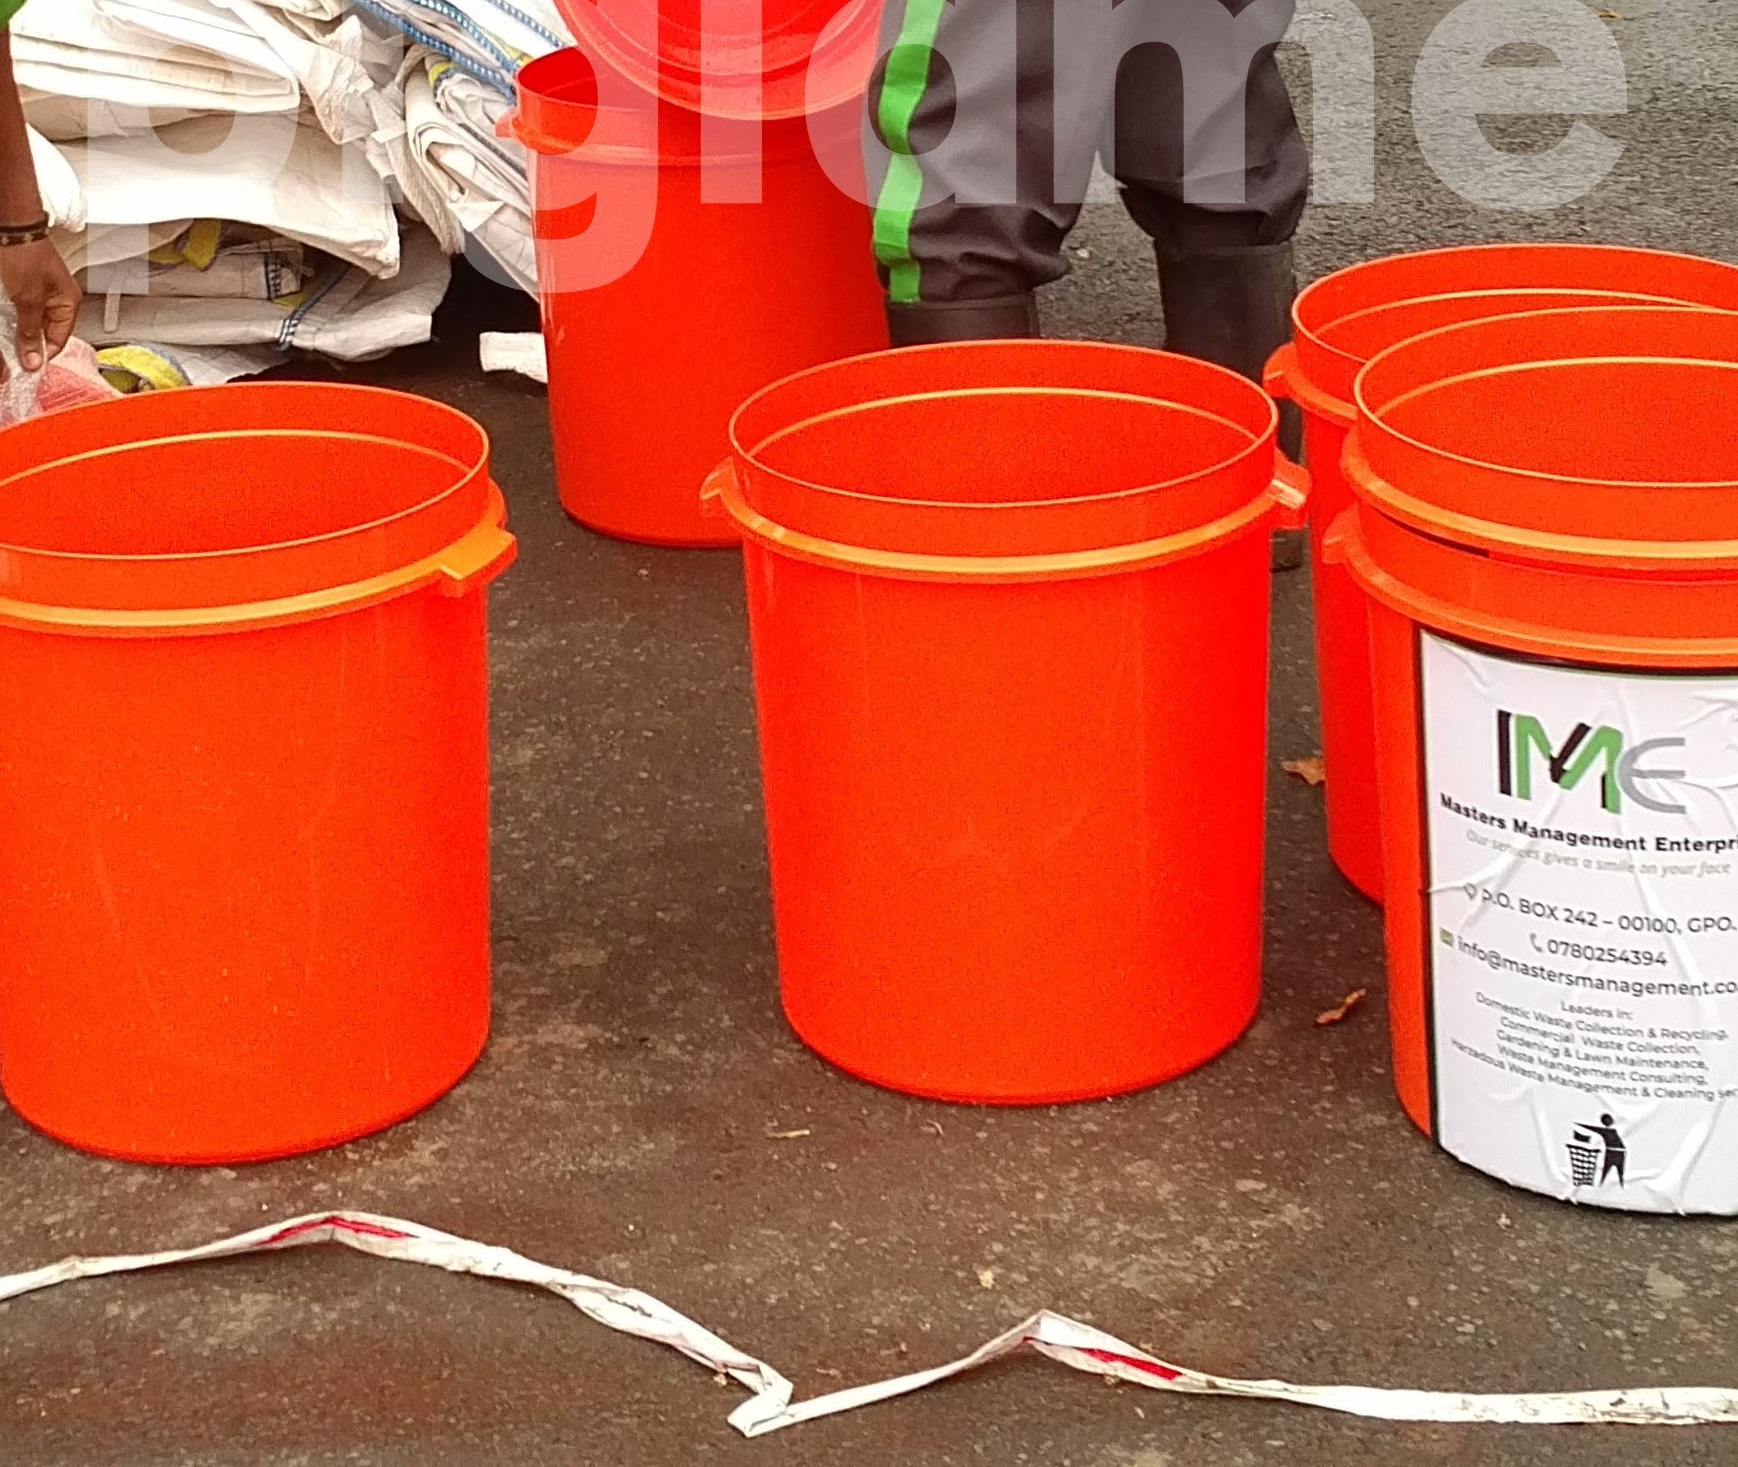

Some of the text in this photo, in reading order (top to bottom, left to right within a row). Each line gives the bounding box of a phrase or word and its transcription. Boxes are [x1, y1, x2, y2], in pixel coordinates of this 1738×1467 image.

[1439, 792, 1507, 830] Masters
[1512, 818, 1648, 851] Management
[1595, 859, 1635, 873] smile
[1661, 863, 1695, 879] your
[1696, 861, 1731, 878] face
[1518, 897, 1559, 921] BOX
[1562, 907, 1599, 928] 242
[1617, 914, 1682, 935] 00100,
[1687, 916, 1738, 933] GPO.
[1547, 938, 1669, 966] 0780254394
[1475, 991, 1531, 1019] Domestic
[1532, 1010, 1573, 1030] Waste
[1575, 1019, 1644, 1038] Collection
[1647, 1027, 1657, 1039] &
[1560, 1000, 1614, 1018] Leaders
[1500, 1016, 1575, 1044] Commercial
[1581, 1035, 1624, 1051] Waste
[1496, 1043, 1535, 1064] Waste
[1537, 1055, 1627, 1081] Management
[1563, 1046, 1573, 1058] &
[1574, 1049, 1612, 1064] Lawn
[1508, 1061, 1545, 1082] Waste
[1547, 1073, 1638, 1097] Management
[1641, 1086, 1651, 1098] &
[1654, 1087, 1715, 1102] Cleaning
